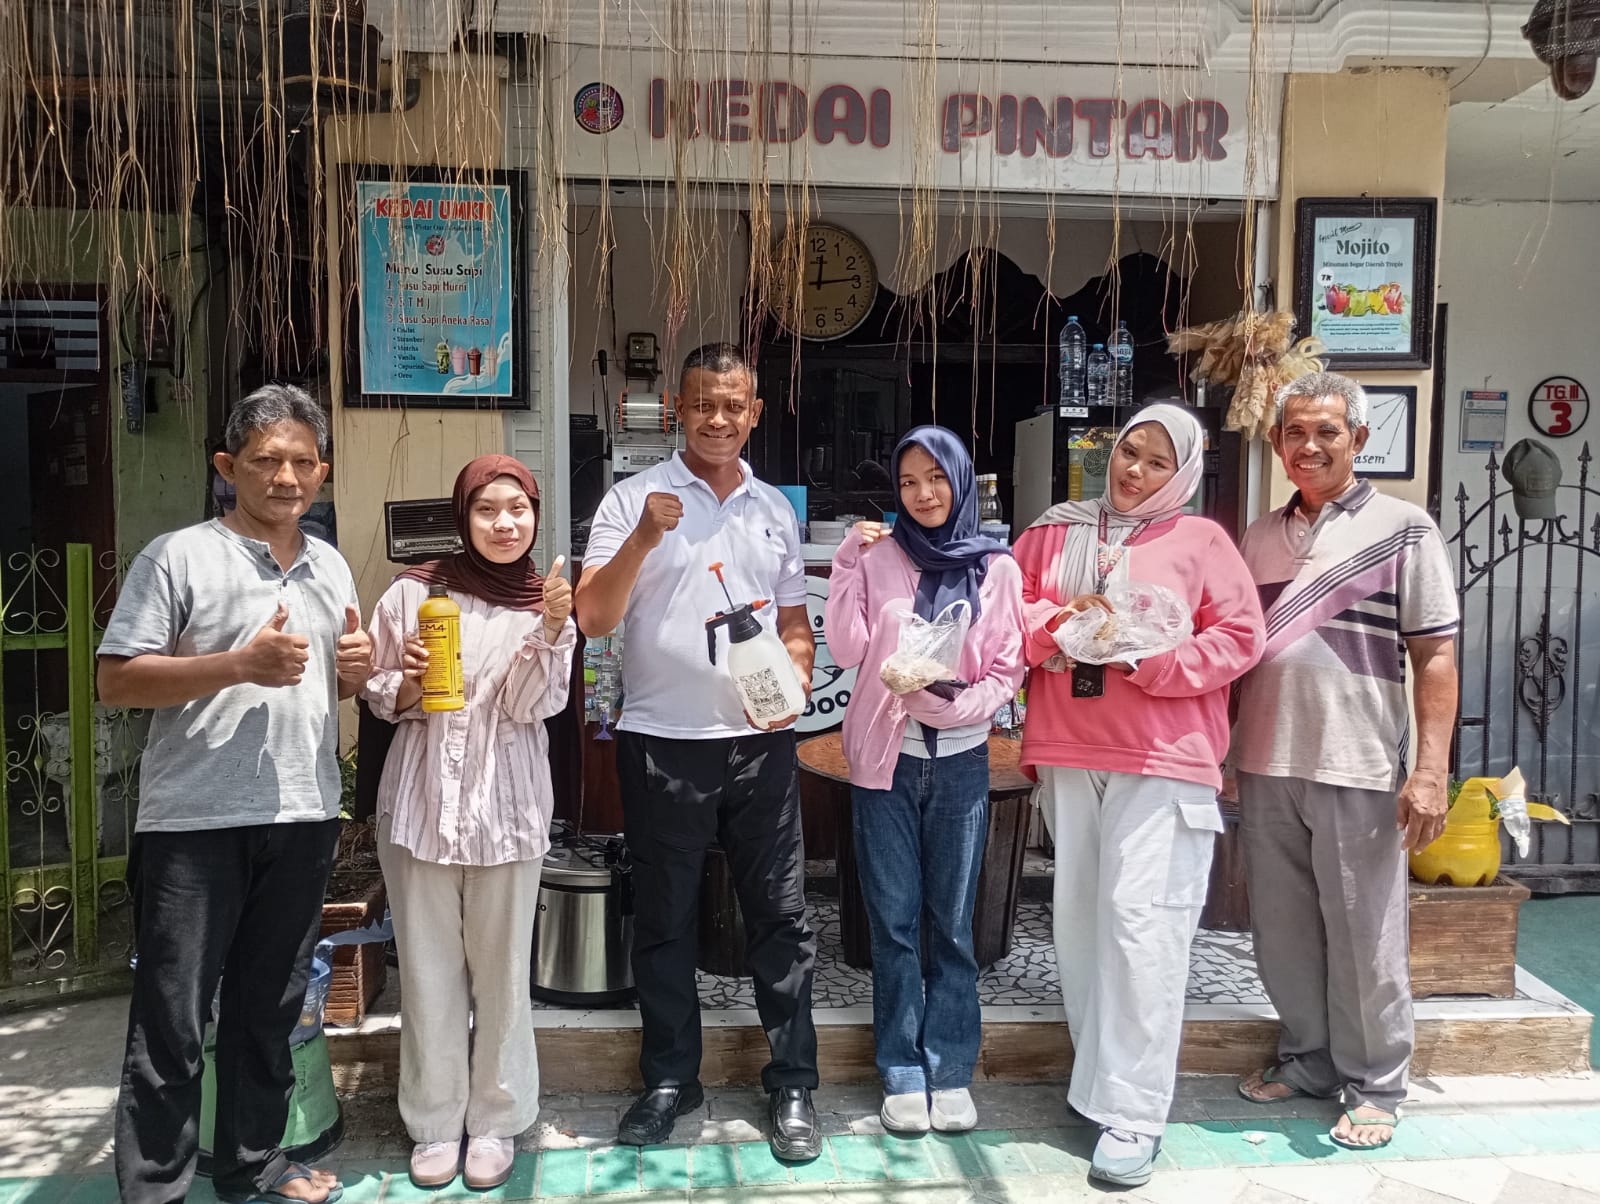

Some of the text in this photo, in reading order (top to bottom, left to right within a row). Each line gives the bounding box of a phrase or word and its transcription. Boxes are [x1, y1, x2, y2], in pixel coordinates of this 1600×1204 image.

[942, 94, 1229, 163] PINTAR
[809, 238, 827, 253] 12
[833, 242, 841, 257] 1
[1336, 238, 1390, 259] Mojito
[425, 263, 453, 275] Susu
[456, 264, 483, 278] Sapi
[846, 256, 857, 271] 2
[851, 274, 862, 290] 3
[846, 294, 858, 309] 4
[442, 315, 467, 325] Aneka
[815, 313, 826, 328] 6
[834, 308, 845, 322] 5
[1548, 401, 1573, 434] 3
